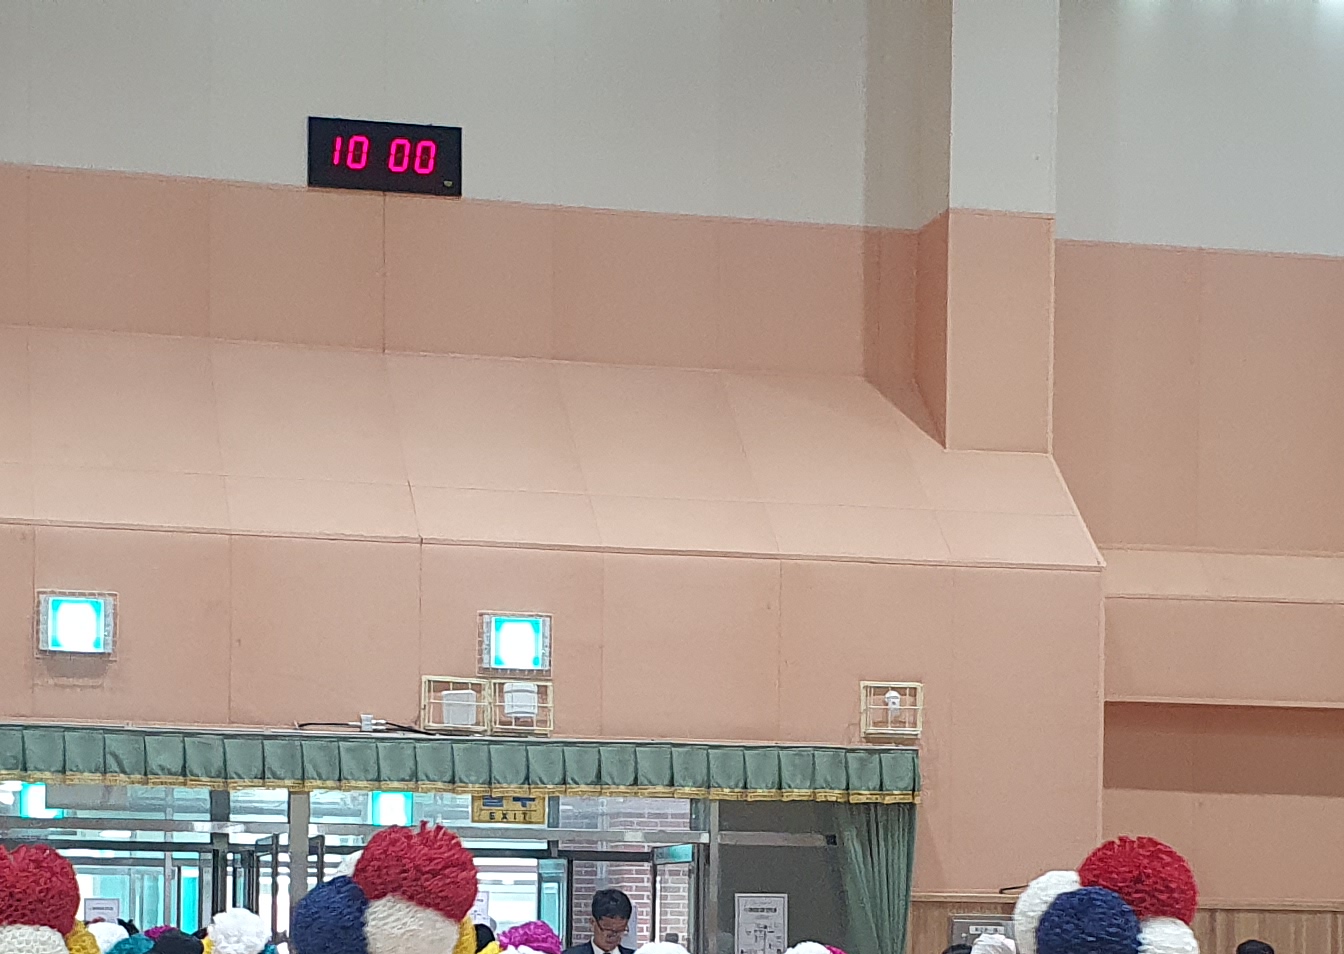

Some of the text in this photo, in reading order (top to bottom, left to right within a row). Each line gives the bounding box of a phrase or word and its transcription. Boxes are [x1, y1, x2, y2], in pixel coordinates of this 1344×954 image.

[333, 134, 436, 174] 10 00
[488, 811, 528, 821] EXIT
